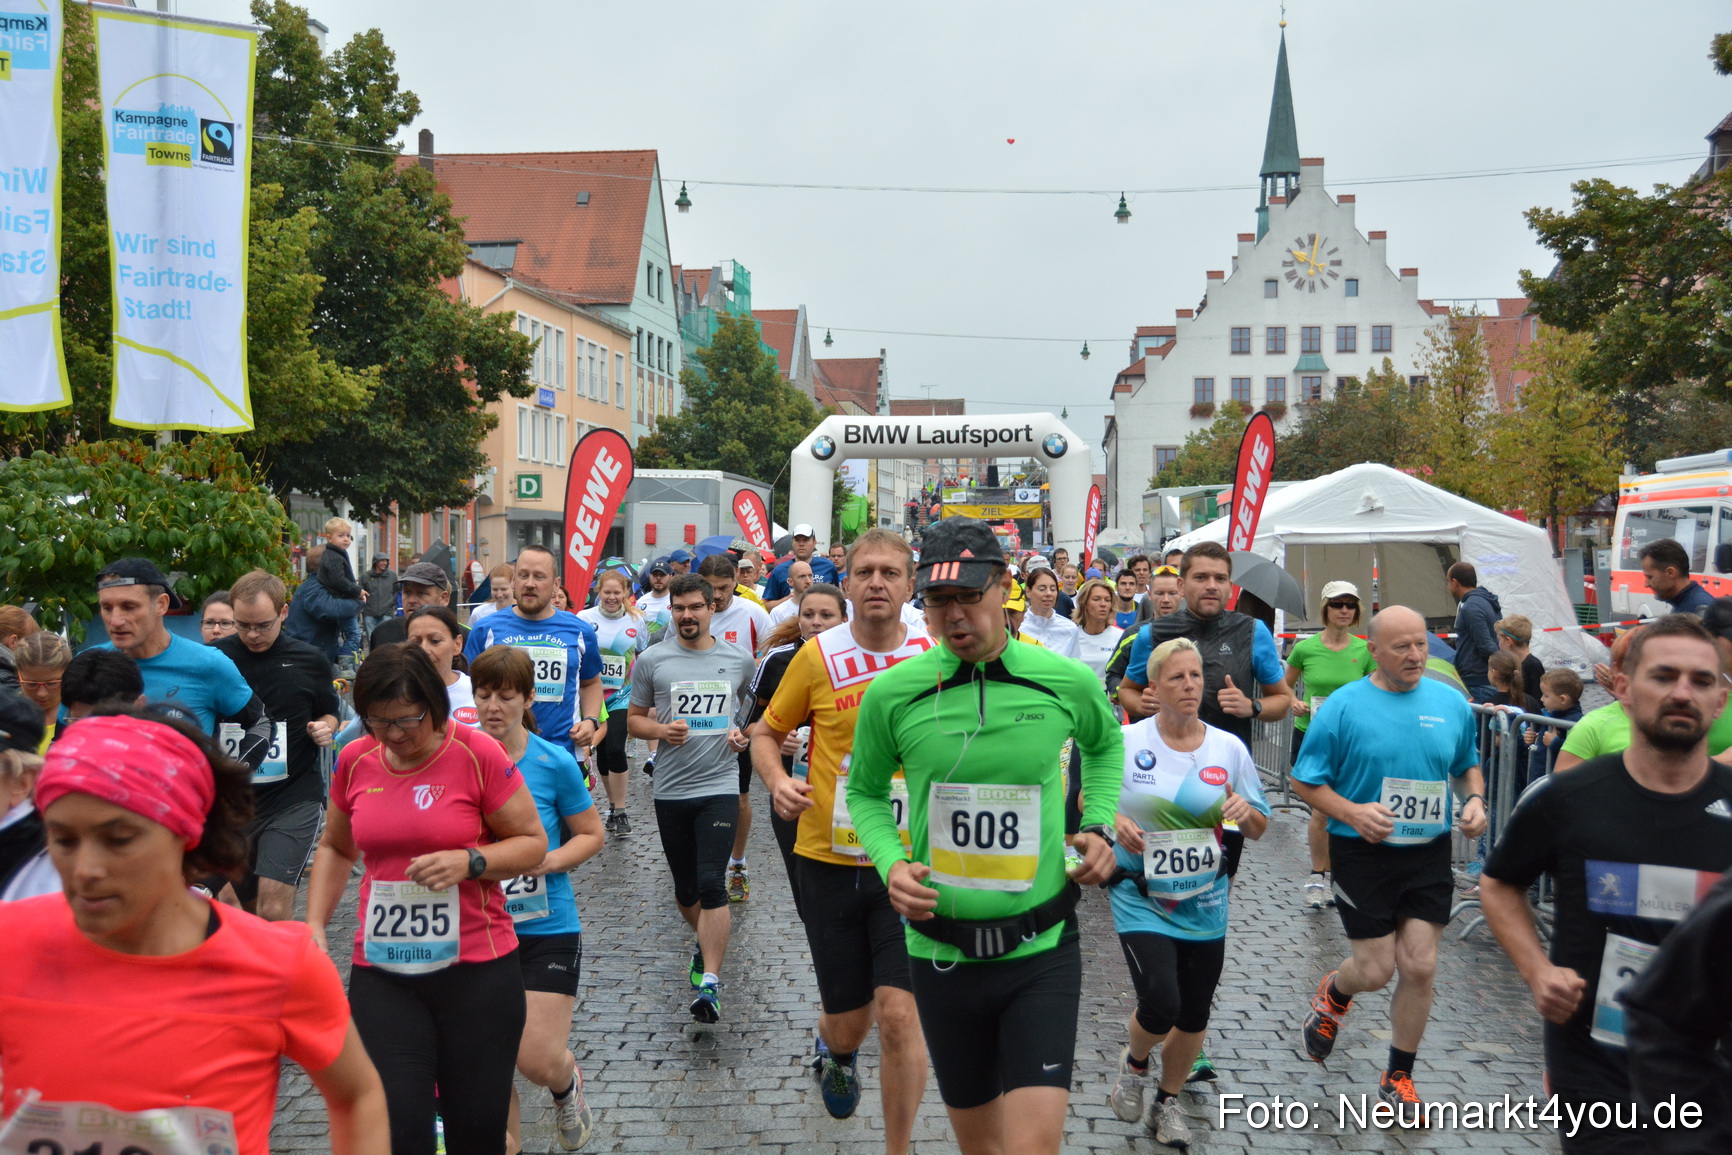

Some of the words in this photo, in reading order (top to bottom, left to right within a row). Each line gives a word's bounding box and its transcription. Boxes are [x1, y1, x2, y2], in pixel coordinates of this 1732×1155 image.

[115, 111, 188, 128] Kampagne
[115, 123, 196, 144] Fairtrade
[148, 147, 191, 162] Towns
[202, 153, 233, 164] FAIRTRADE
[116, 231, 158, 254] Wir
[167, 235, 216, 259] sind
[119, 264, 233, 292] Fairtrade-
[124, 297, 192, 320] Stadt!
[844, 424, 910, 444] BMW
[917, 424, 1033, 448] Laufsport
[521, 477, 538, 495] D
[1232, 434, 1270, 552] REWE
[568, 446, 623, 571] REWE
[981, 507, 1004, 516] ZIEL
[1086, 493, 1100, 553] REWE
[502, 635, 525, 644] Wyk
[545, 634, 568, 648] Föhr
[533, 660, 562, 681] 36
[678, 694, 727, 714] 2277
[691, 719, 713, 728] Heiko
[1024, 713, 1045, 721] asics
[225, 738, 280, 760] 25
[1132, 772, 1156, 780] PARTL
[1203, 771, 1226, 781] Hervis
[977, 788, 1031, 801] BOCK
[1389, 794, 1441, 820] 2814
[951, 810, 1020, 850] 608
[1177, 832, 1210, 842] BOCK
[1401, 825, 1424, 836] Franz
[1153, 846, 1215, 875] 2664
[505, 873, 538, 895] 29
[1172, 879, 1197, 891] Petra
[1640, 895, 1690, 912] MÜLLER
[373, 903, 450, 937] 2255
[387, 947, 432, 963] Birgitta
